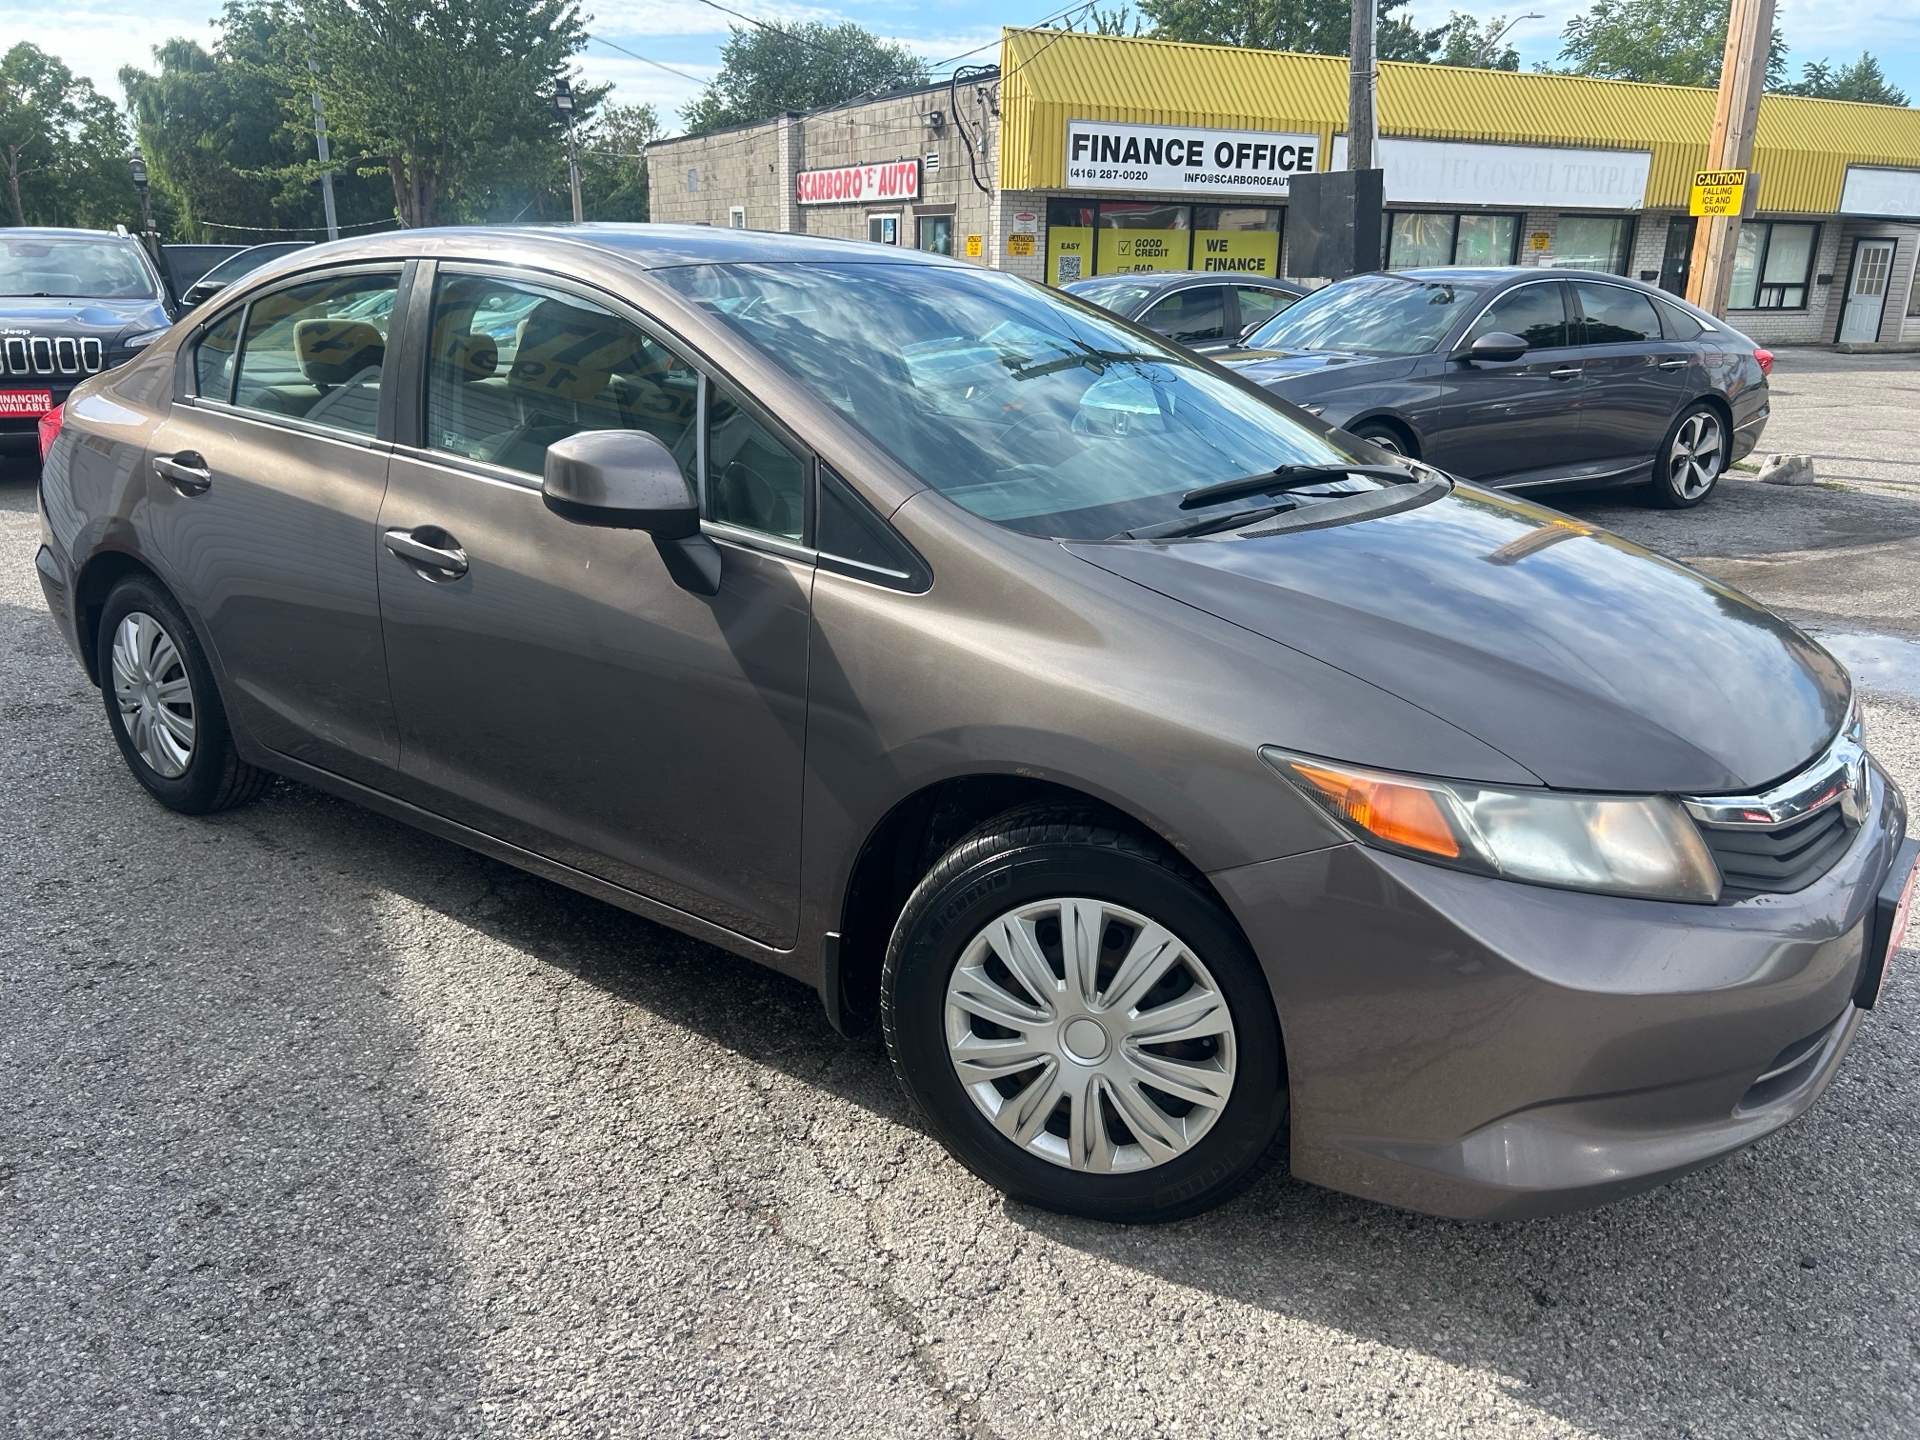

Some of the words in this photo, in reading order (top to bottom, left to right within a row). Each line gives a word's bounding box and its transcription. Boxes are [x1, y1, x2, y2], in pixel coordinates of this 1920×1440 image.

[1072, 133, 1204, 167] FINANCE
[1214, 141, 1314, 172] OFFICE
[1070, 168, 1096, 178] (416)
[1099, 169, 1148, 180] 287-0020
[1563, 164, 1645, 196] TEMPLE
[1697, 173, 1743, 185] CAUTION
[796, 168, 863, 202] SCARBORO
[878, 162, 917, 196] AUTO
[1702, 187, 1733, 195] FALLING
[1702, 196, 1714, 204] ICE
[1715, 196, 1731, 204] AND
[1135, 239, 1163, 248] GOOD
[1206, 239, 1228, 252] WE
[1135, 249, 1169, 257] CREDIT
[1134, 264, 1153, 272] BAD
[1205, 257, 1266, 272] FINANCE
[0, 328, 31, 336] Jeep
[0, 394, 50, 403] INANCING
[929, 871, 1008, 941] MICHELIN
